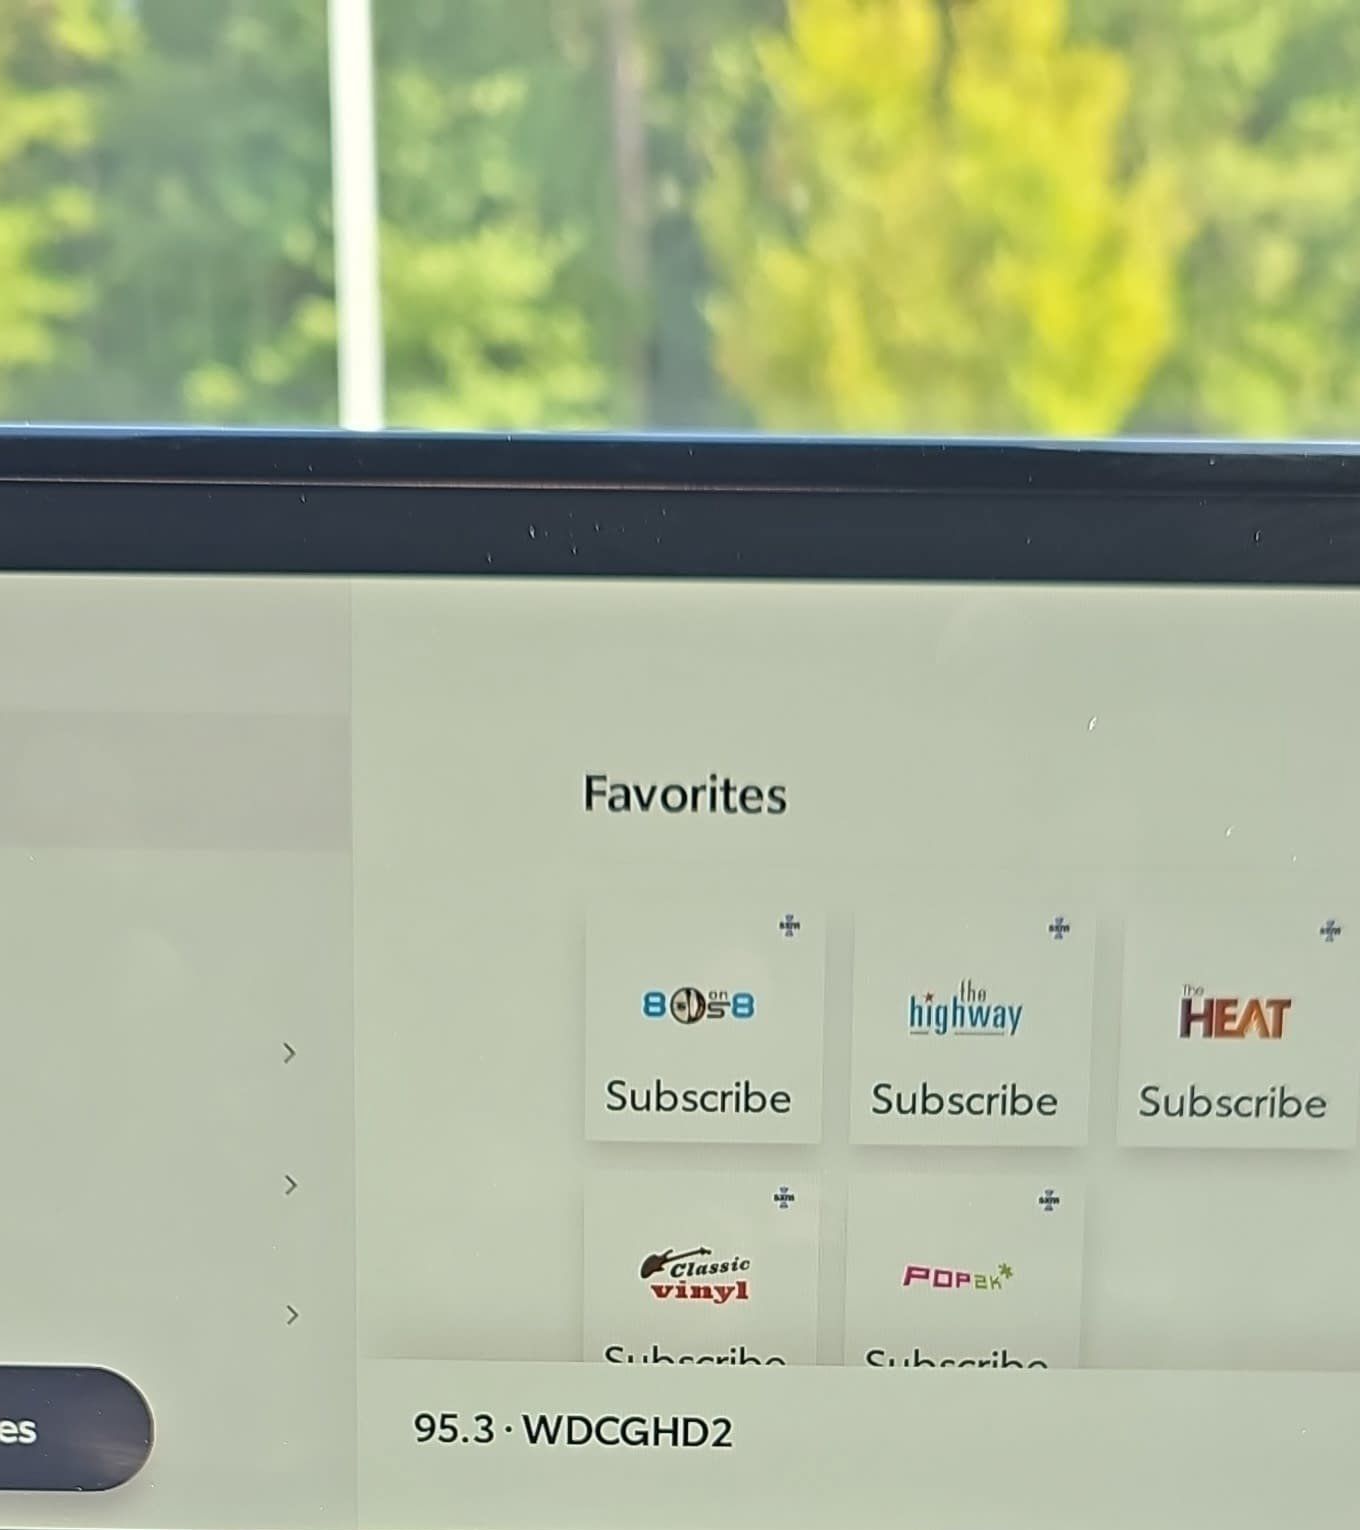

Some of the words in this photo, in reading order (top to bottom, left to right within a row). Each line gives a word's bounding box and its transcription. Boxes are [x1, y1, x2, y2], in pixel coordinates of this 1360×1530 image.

[584, 774, 788, 815] Favorites
[909, 994, 1023, 1036] highway
[1179, 997, 1292, 1039] HEAT
[605, 1079, 792, 1114] Subscribe
[871, 1082, 1058, 1117] Subscribe
[1139, 1085, 1328, 1121] Subscribe
[669, 1256, 751, 1279] Classic
[650, 1280, 749, 1304] vinyl
[414, 1412, 496, 1443] 95.3
[521, 1413, 733, 1448] WDCGHD2
